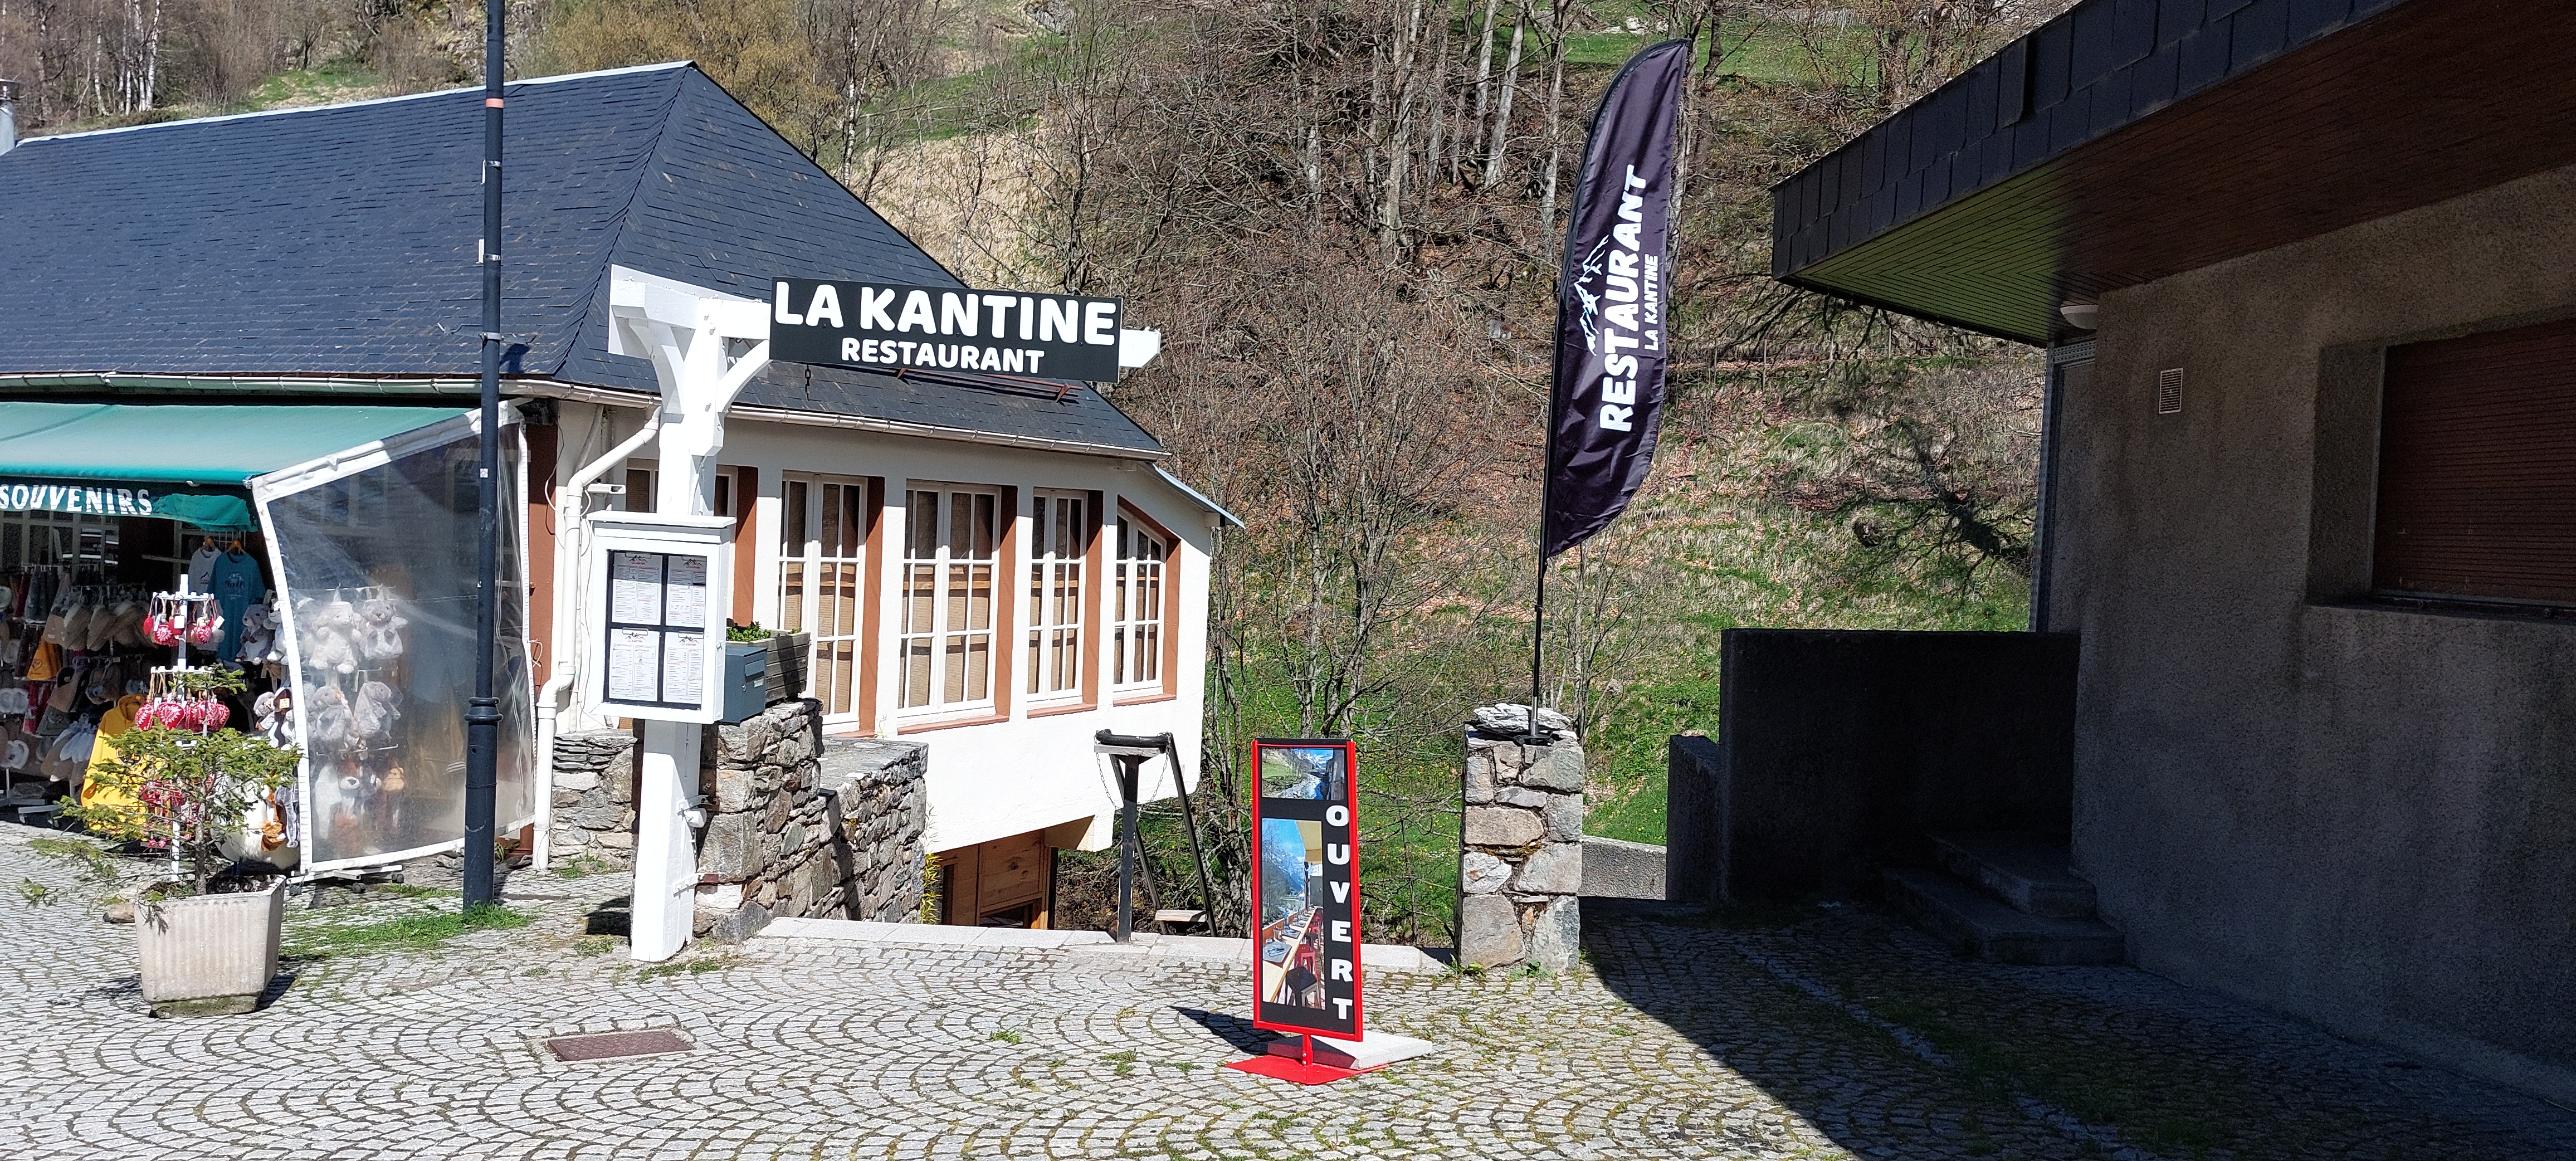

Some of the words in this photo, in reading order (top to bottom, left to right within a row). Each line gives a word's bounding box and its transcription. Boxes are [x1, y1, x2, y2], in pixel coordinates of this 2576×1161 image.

[774, 281, 844, 328] LA
[860, 286, 1116, 345] KANTINE
[1599, 164, 1647, 432] RESTAURANT
[1644, 253, 1658, 325] KANTINE
[841, 337, 1045, 374] RESTAURANT
[1644, 330, 1659, 351] LA
[0, 484, 153, 516] SOUVENIRS
[1325, 804, 1354, 1020] OUVERT
